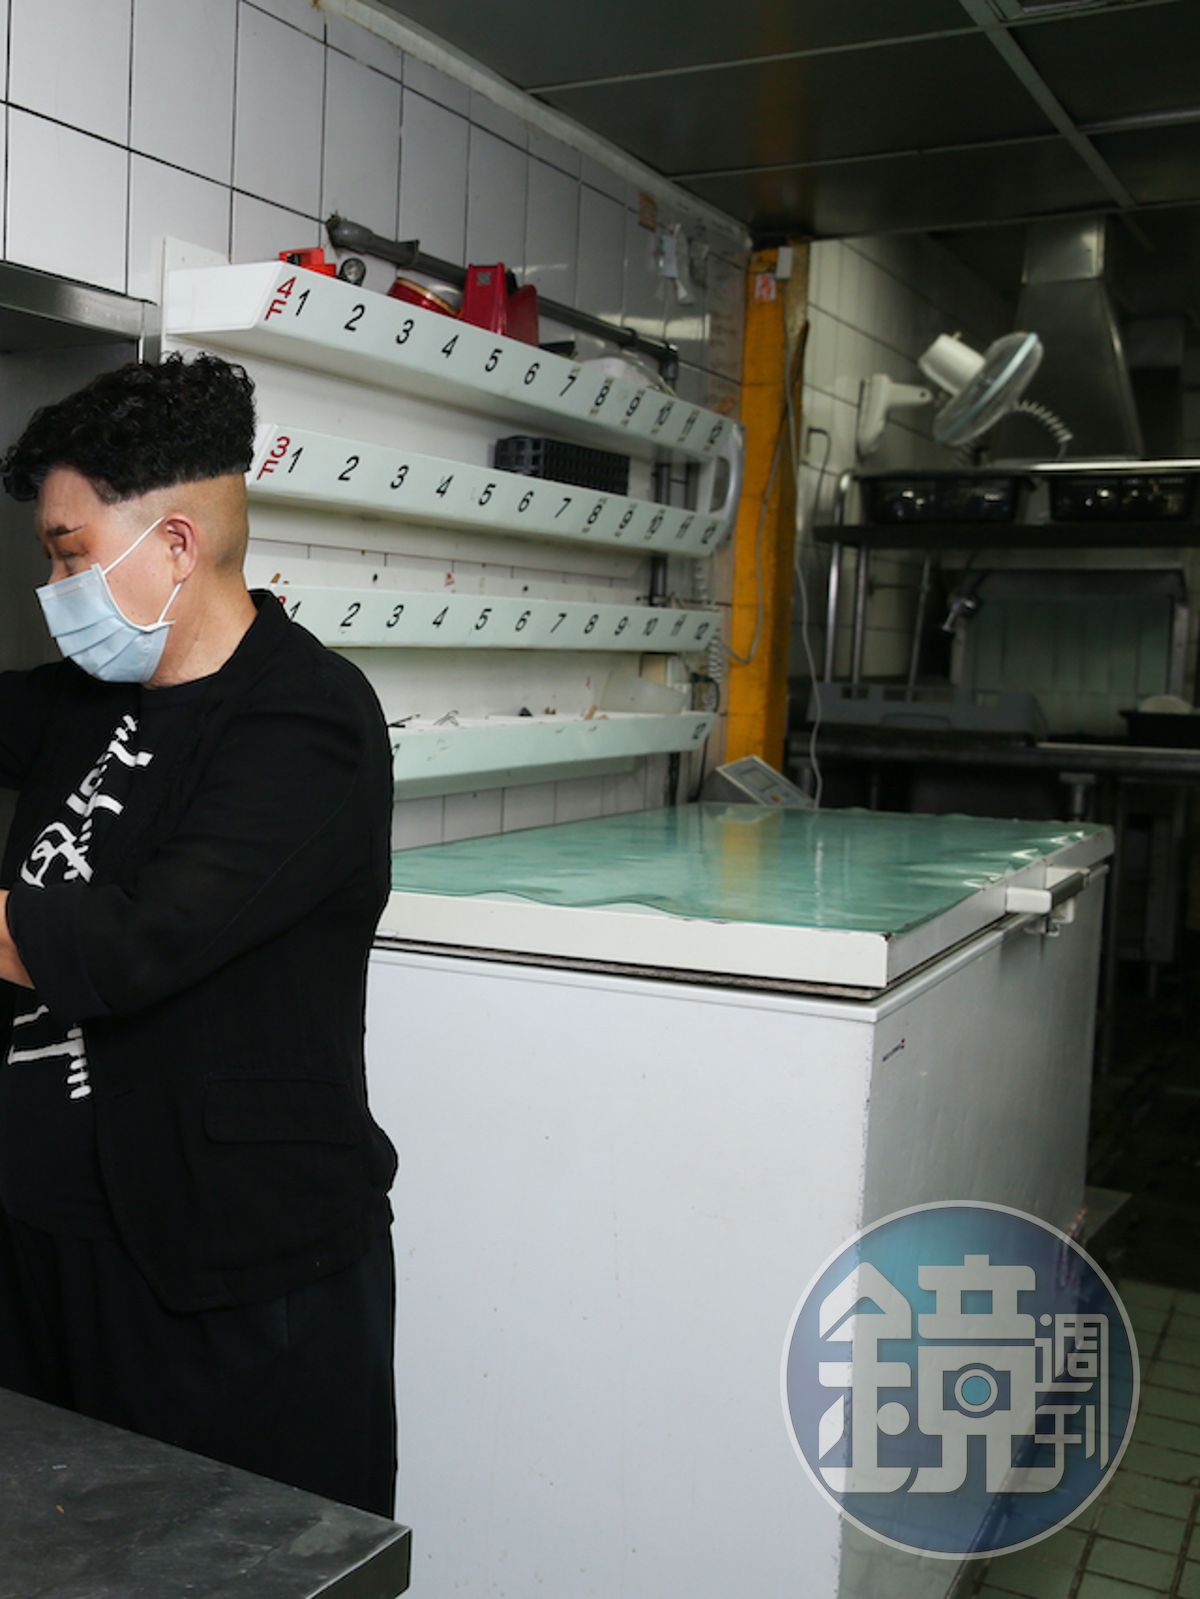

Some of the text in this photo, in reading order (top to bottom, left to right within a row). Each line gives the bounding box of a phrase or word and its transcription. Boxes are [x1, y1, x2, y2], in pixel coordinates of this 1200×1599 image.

[296, 289, 310, 316] 1
[344, 304, 365, 331] 2
[396, 319, 414, 344] 3
[441, 334, 459, 358] 4
[485, 348, 502, 372] 5
[524, 362, 540, 385] 6
[560, 374, 576, 397] 7
[594, 385, 610, 407] 8
[626, 396, 641, 416] 9
[288, 447, 304, 473] 1
[338, 455, 359, 481] 2
[390, 464, 409, 489] 3
[436, 474, 454, 498] 4
[478, 483, 496, 506] 5
[518, 490, 534, 512] 6
[554, 497, 572, 518] 7
[587, 504, 602, 525] 8
[619, 510, 633, 530] 9
[289, 600, 302, 621] 1
[340, 602, 361, 627] 2
[386, 604, 404, 628] 3
[432, 606, 449, 628] 4
[475, 608, 492, 630] 5
[515, 610, 531, 632] 6
[550, 613, 567, 633] 7
[583, 614, 599, 634] 8
[614, 616, 628, 636] 9
